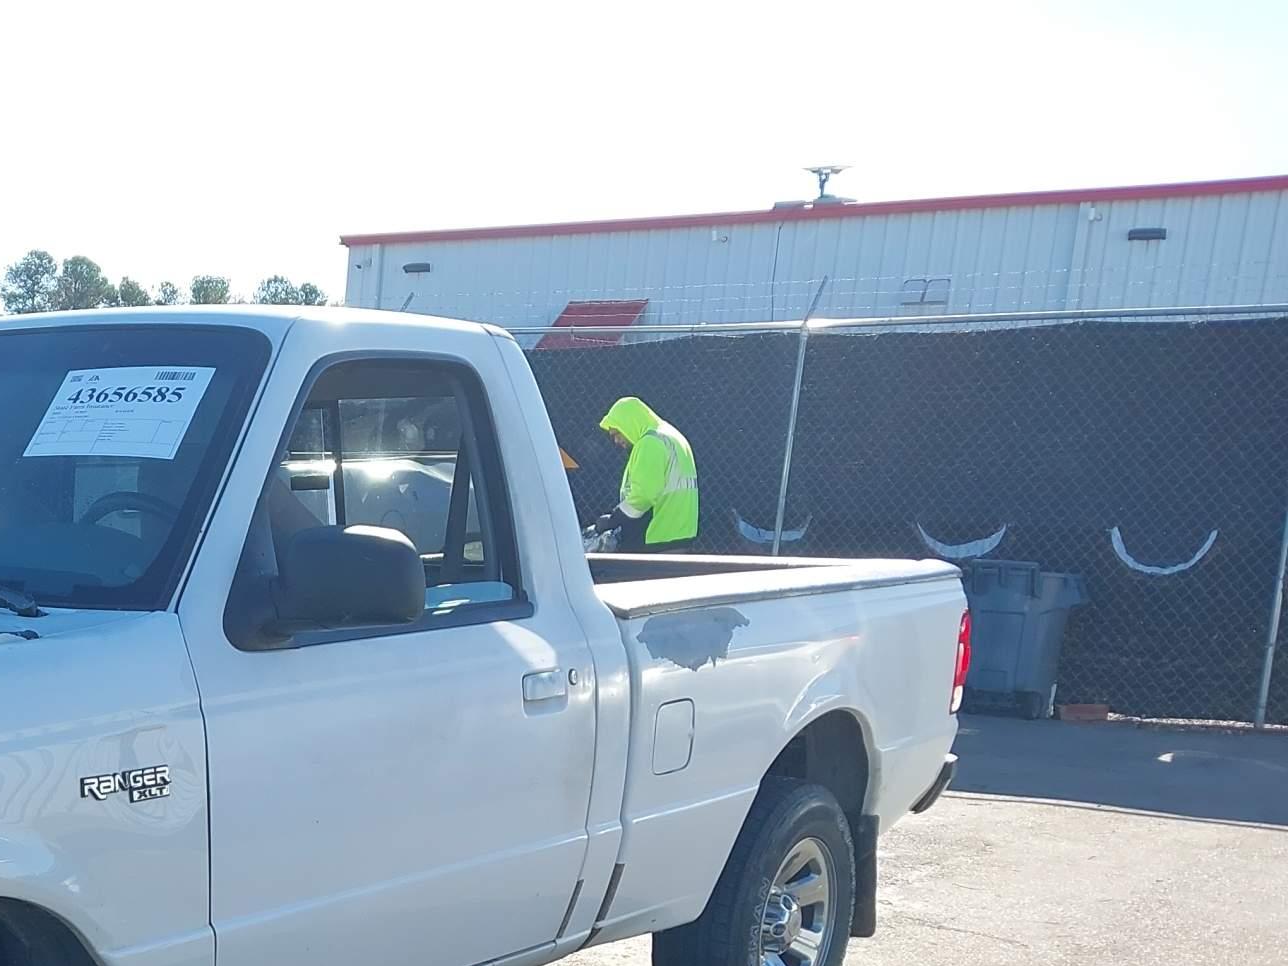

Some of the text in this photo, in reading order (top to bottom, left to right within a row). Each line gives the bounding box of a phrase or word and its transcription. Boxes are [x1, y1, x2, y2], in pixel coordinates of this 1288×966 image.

[66, 385, 188, 404] 43656585
[79, 764, 172, 801] RANGER
[136, 786, 168, 800] XLT
